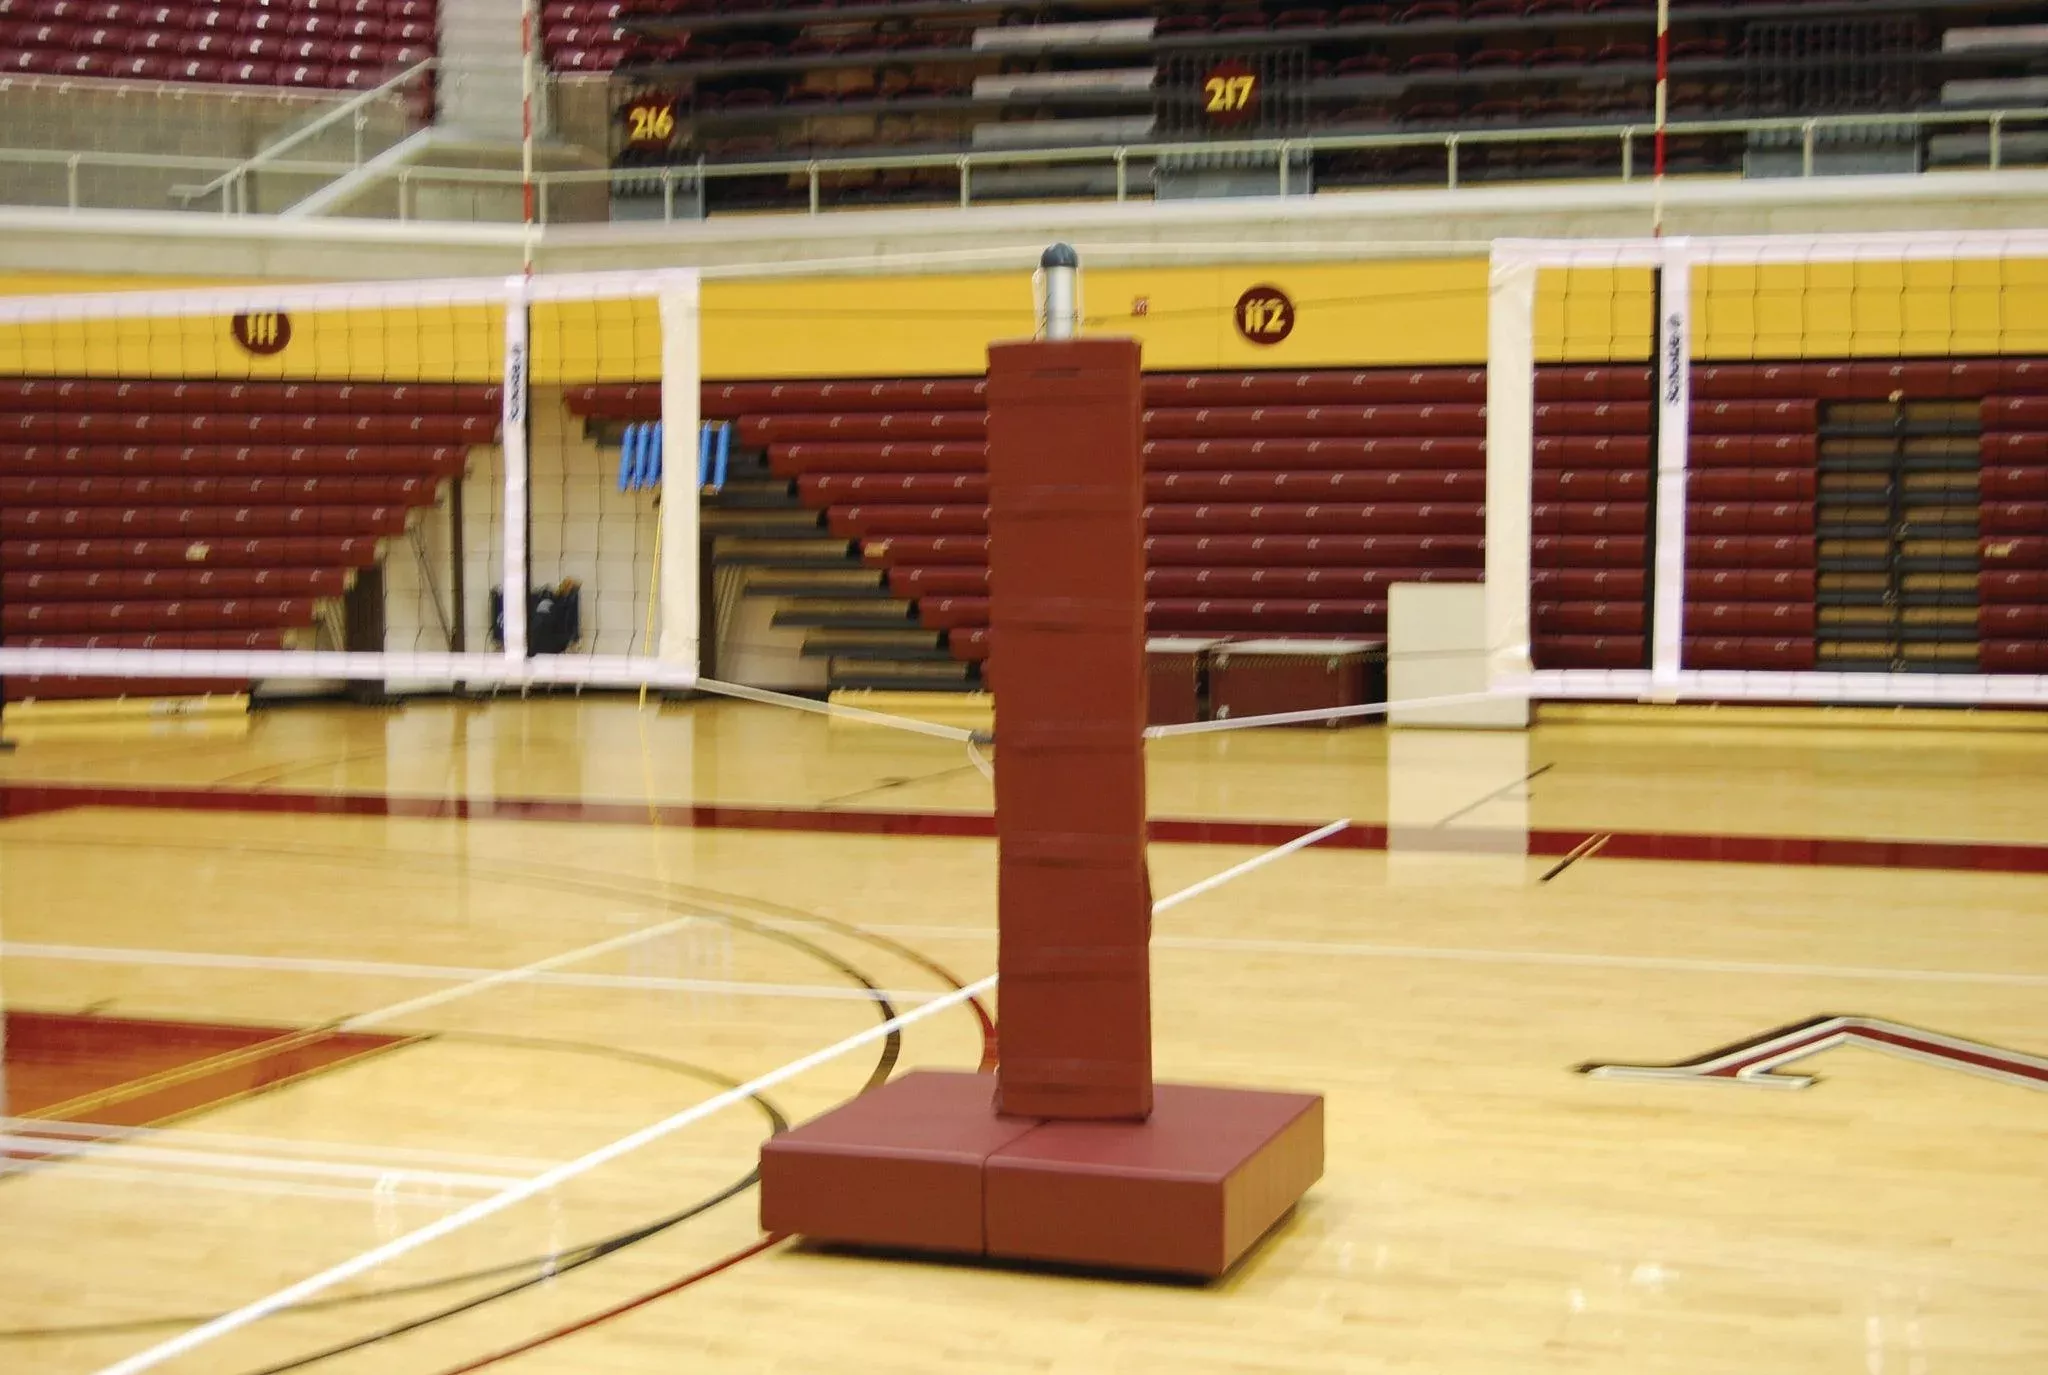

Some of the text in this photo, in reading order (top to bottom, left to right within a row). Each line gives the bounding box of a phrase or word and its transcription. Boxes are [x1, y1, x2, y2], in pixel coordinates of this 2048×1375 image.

[1205, 75, 1255, 111] 217
[630, 106, 673, 140] 216
[1245, 298, 1285, 333] 112
